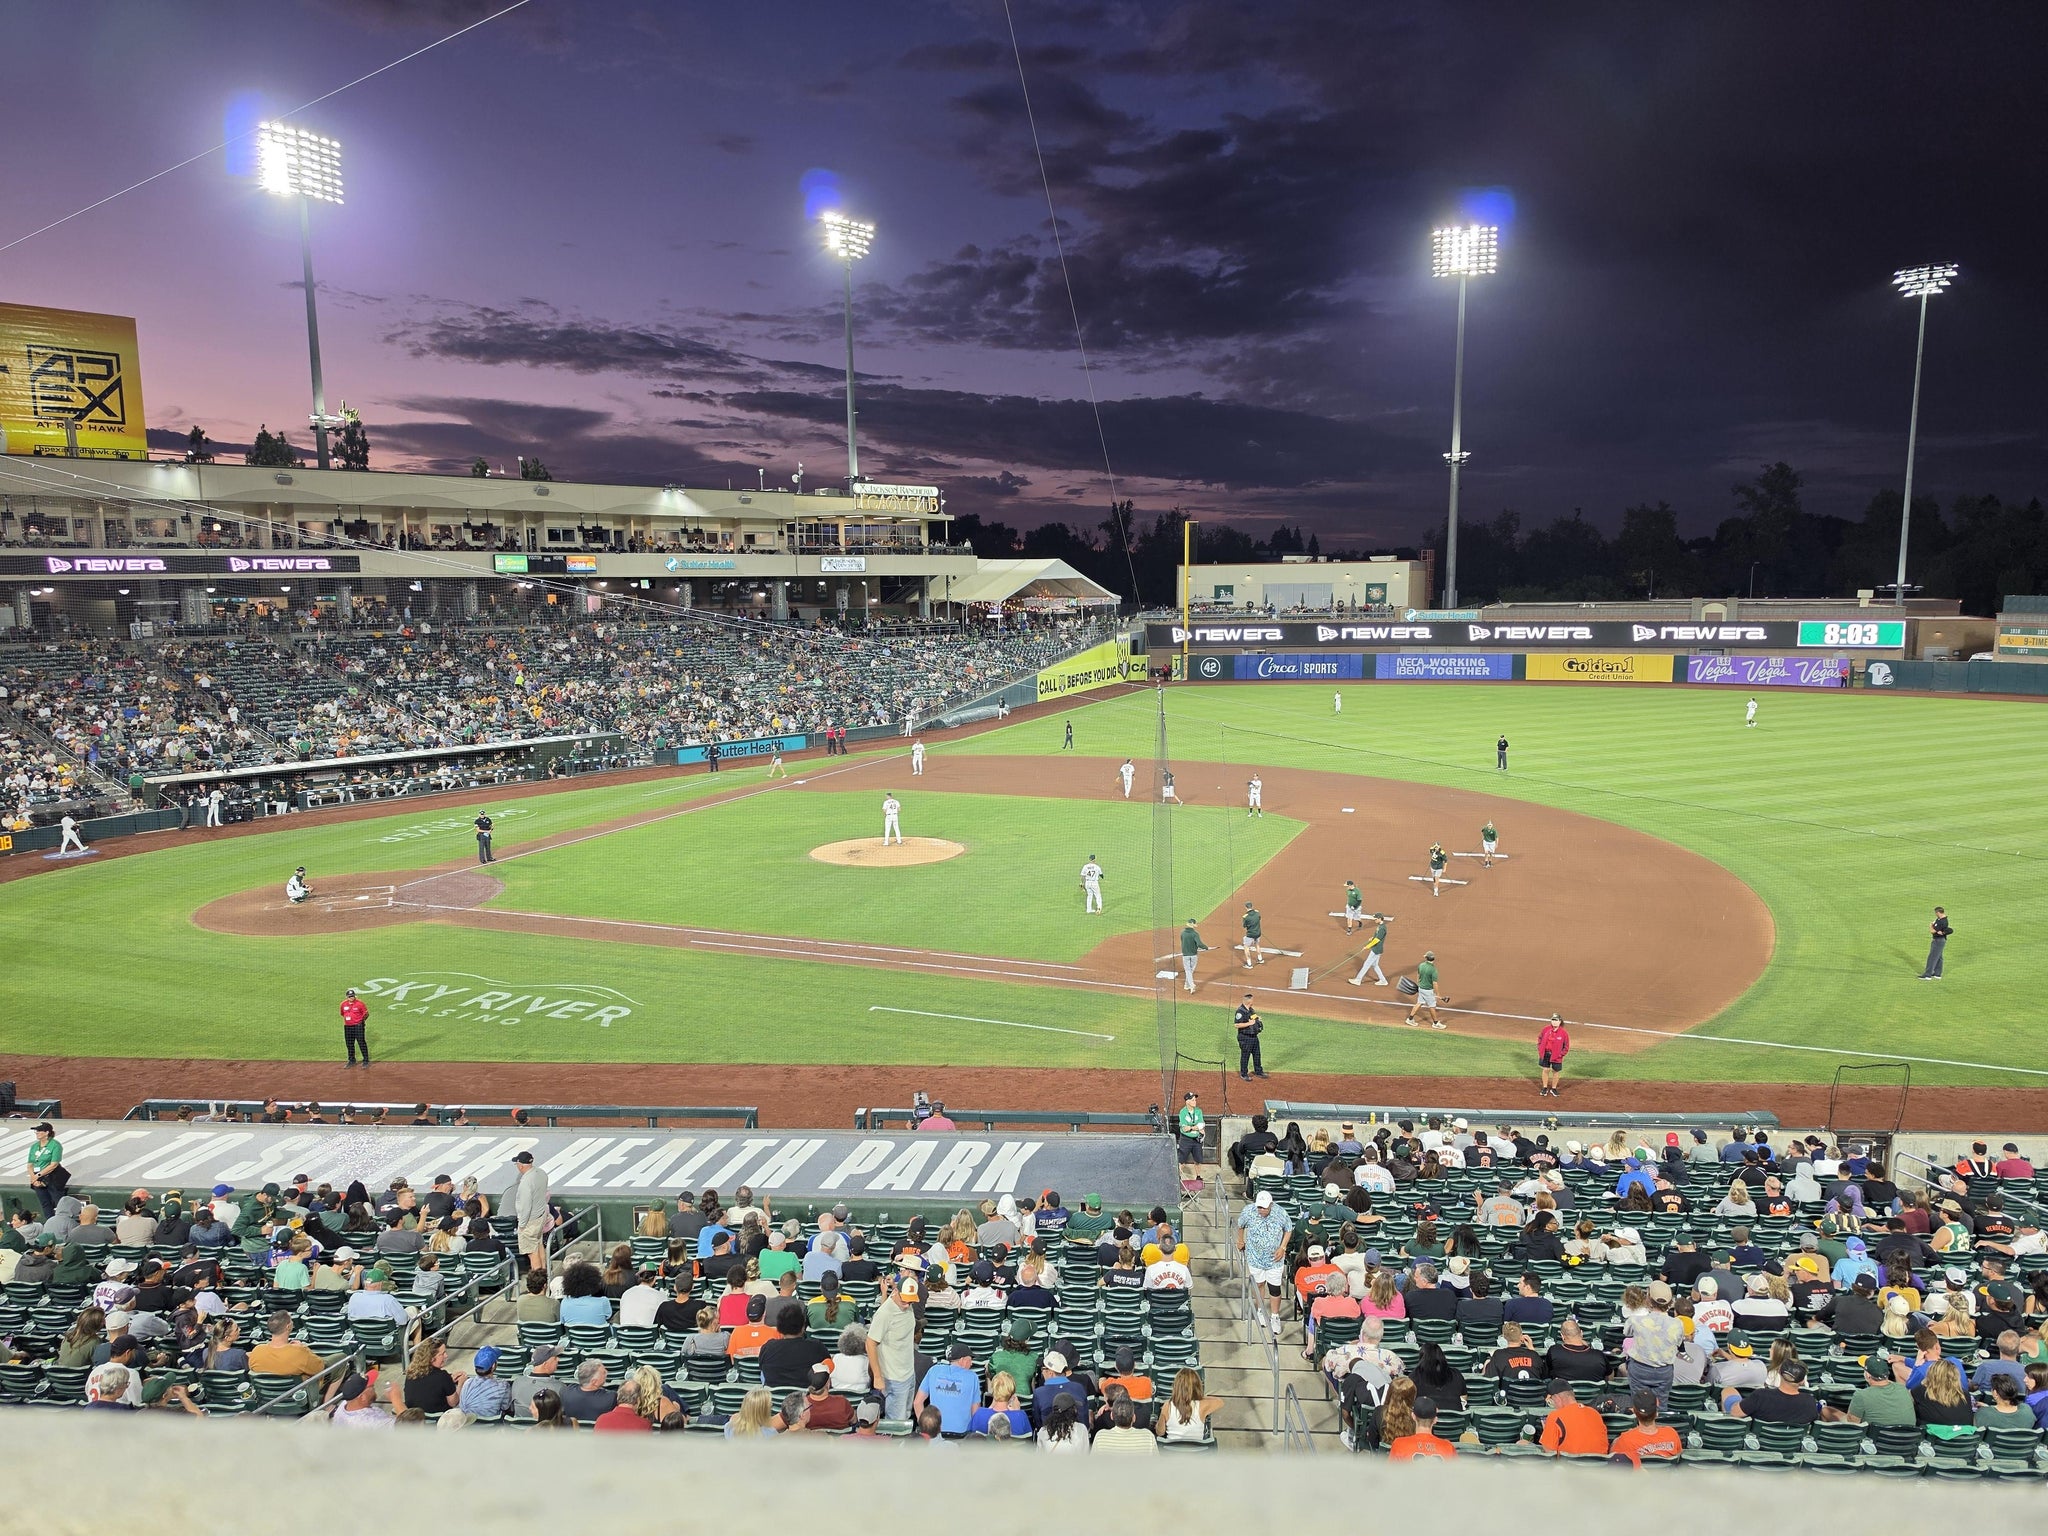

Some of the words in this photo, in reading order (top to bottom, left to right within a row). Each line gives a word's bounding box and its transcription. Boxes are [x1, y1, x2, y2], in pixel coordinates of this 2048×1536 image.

[36, 421, 51, 429] AT
[56, 422, 83, 431] RD
[89, 424, 125, 433] HAWK
[680, 559, 708, 569] Sutter
[708, 559, 736, 570] Health
[1419, 612, 1448, 621] Sutter
[1448, 611, 1477, 620] Health
[1823, 623, 1878, 645] 8:03
[1203, 662, 1217, 673] 42
[1257, 656, 1298, 678] Circa
[1303, 662, 1338, 674] SPORTS
[1396, 657, 1424, 667] NECA
[1429, 657, 1486, 667] WORKING
[1717, 657, 1731, 666] LAS
[1769, 658, 1784, 667] LAS
[1823, 659, 1838, 668] LAS
[1430, 666, 1490, 676] TOGETHER
[1689, 658, 1739, 682] Vegas
[1741, 659, 1791, 684] Vegas
[1794, 660, 1842, 685] Vegas
[1039, 678, 1058, 695] CALL
[1067, 671, 1093, 689] BEFORE
[1093, 668, 1106, 683] YOU
[1106, 666, 1117, 680] DIG
[716, 744, 752, 758] Sutter
[750, 739, 785, 754] Health
[1086, 870, 1096, 878] 47
[354, 978, 471, 1002] SKY
[459, 990, 632, 1028] RIVER
[387, 1002, 521, 1025] CASINO
[99, 1131, 255, 1180] TO
[545, 1137, 829, 1189] HEALTH
[818, 1139, 1044, 1193] PARK
[1508, 1356, 1532, 1368] RIPKEN
